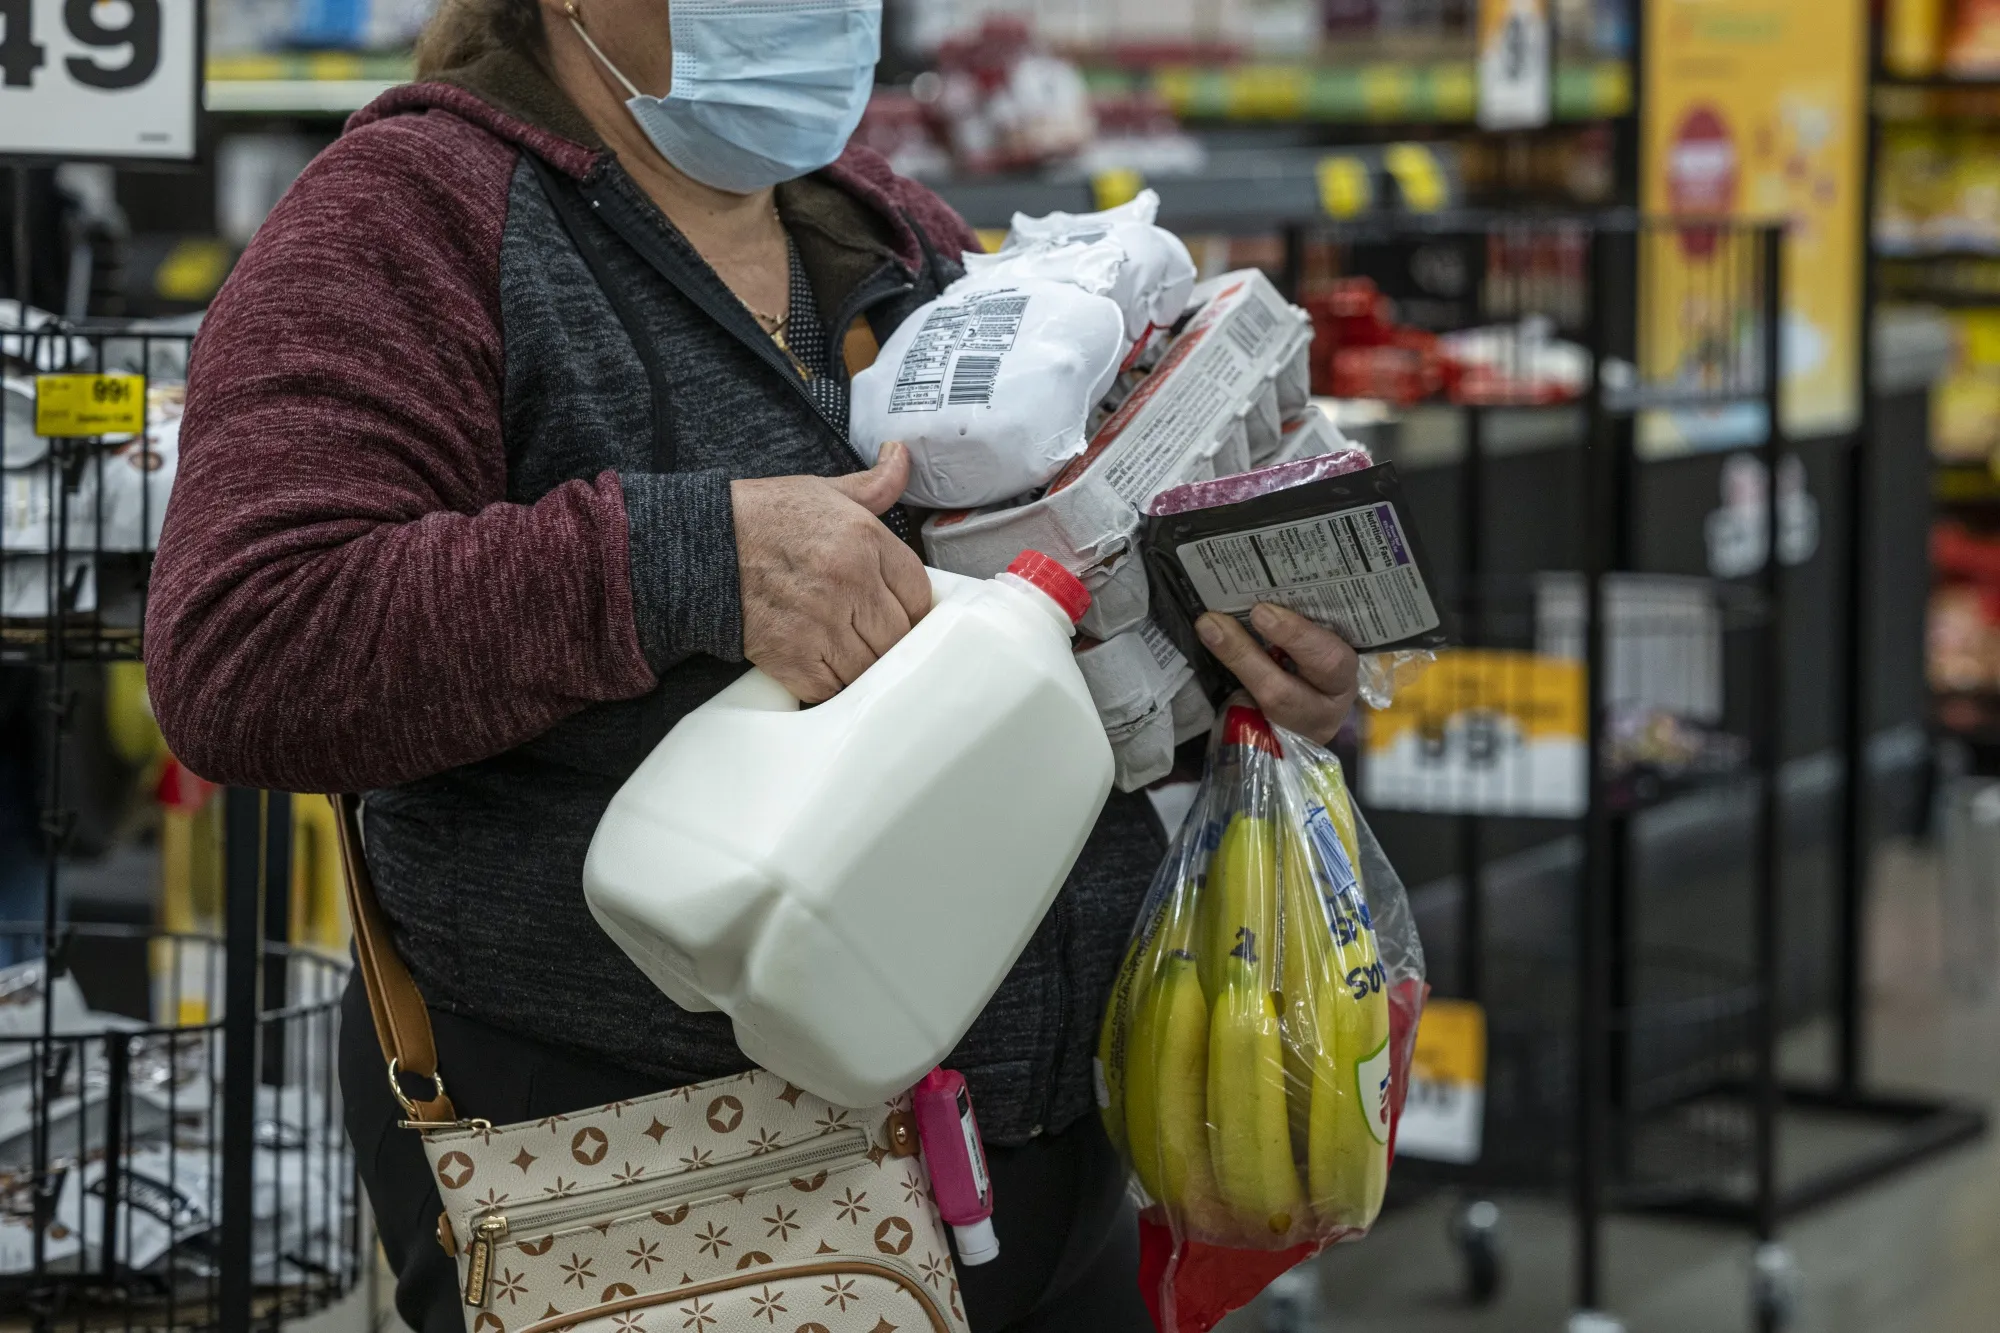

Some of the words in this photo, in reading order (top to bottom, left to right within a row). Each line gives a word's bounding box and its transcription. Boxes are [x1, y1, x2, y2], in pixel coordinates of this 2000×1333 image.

[0, 0, 162, 90] 49
[1255, 534, 1265, 549] Protein
[1284, 528, 1295, 544] Sodium
[1313, 522, 1323, 534] Total
[1330, 518, 1342, 536] Calories
[1338, 516, 1350, 535] Amount
[1348, 543, 1360, 560] Serving
[1364, 510, 1382, 545] Nutrition
[1378, 545, 1393, 567] Facts
[1277, 529, 1286, 541] Total
[1282, 541, 1298, 569] Carbohydrate
